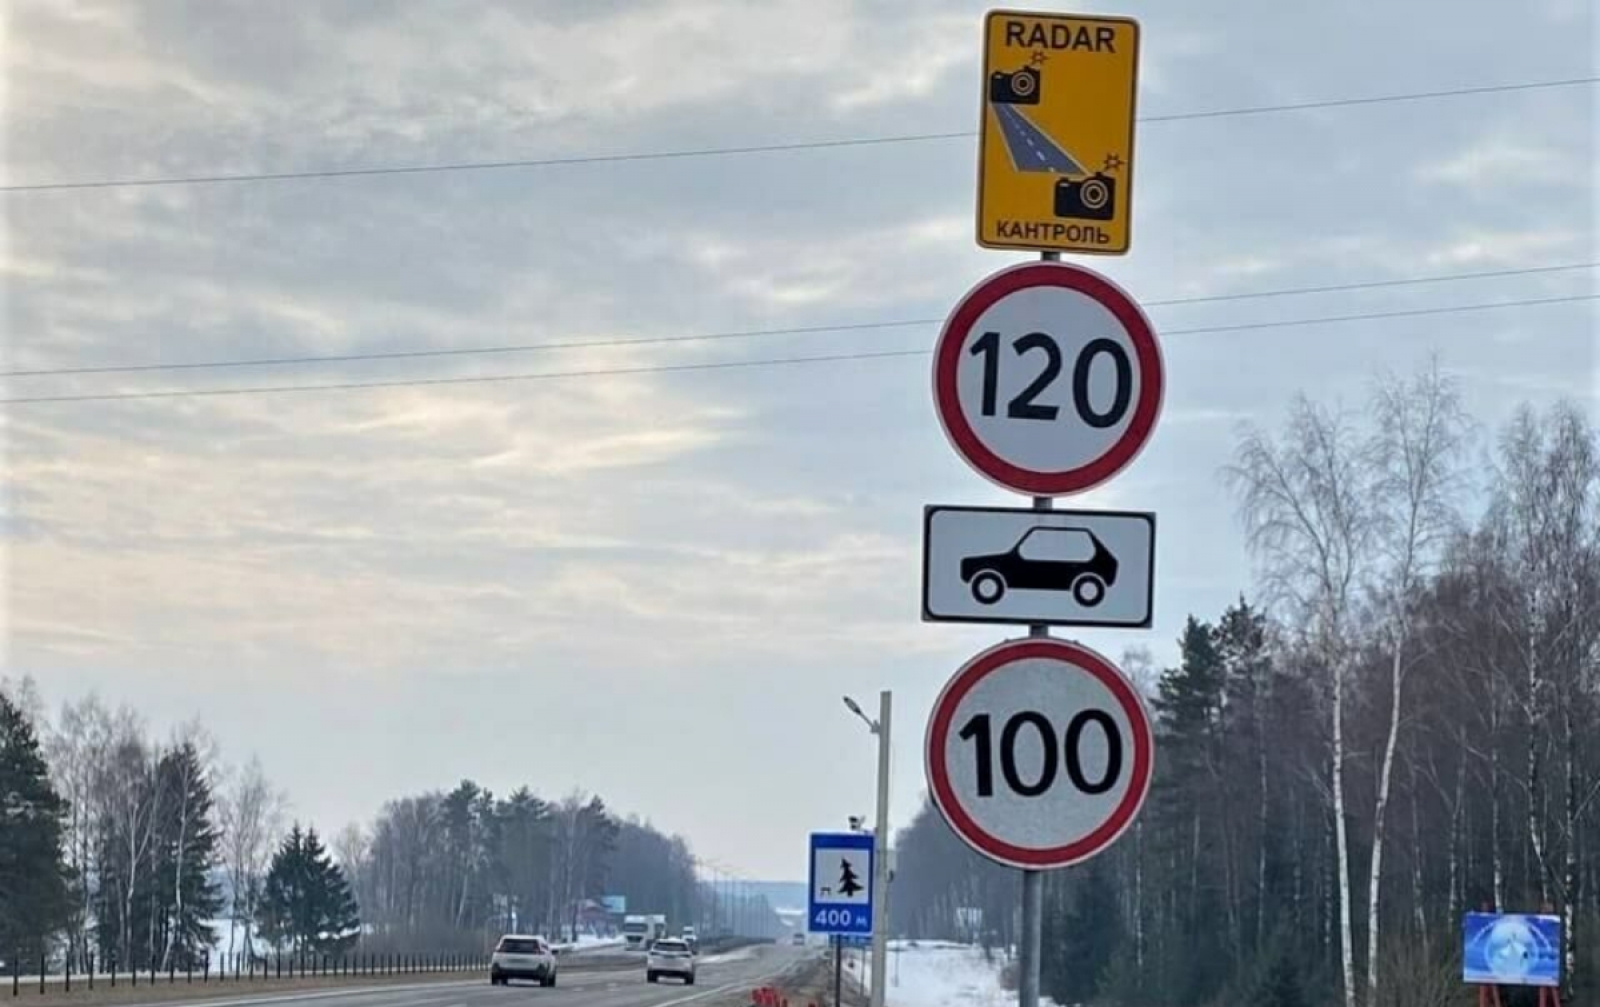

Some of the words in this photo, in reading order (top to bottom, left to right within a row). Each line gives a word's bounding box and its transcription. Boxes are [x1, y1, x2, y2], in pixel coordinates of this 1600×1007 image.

[1005, 21, 1116, 53] RADAR
[997, 220, 1110, 244] КАНТРОЛЬ
[970, 332, 1132, 428] 120
[960, 709, 1122, 797] 100
[815, 910, 851, 926] 400
